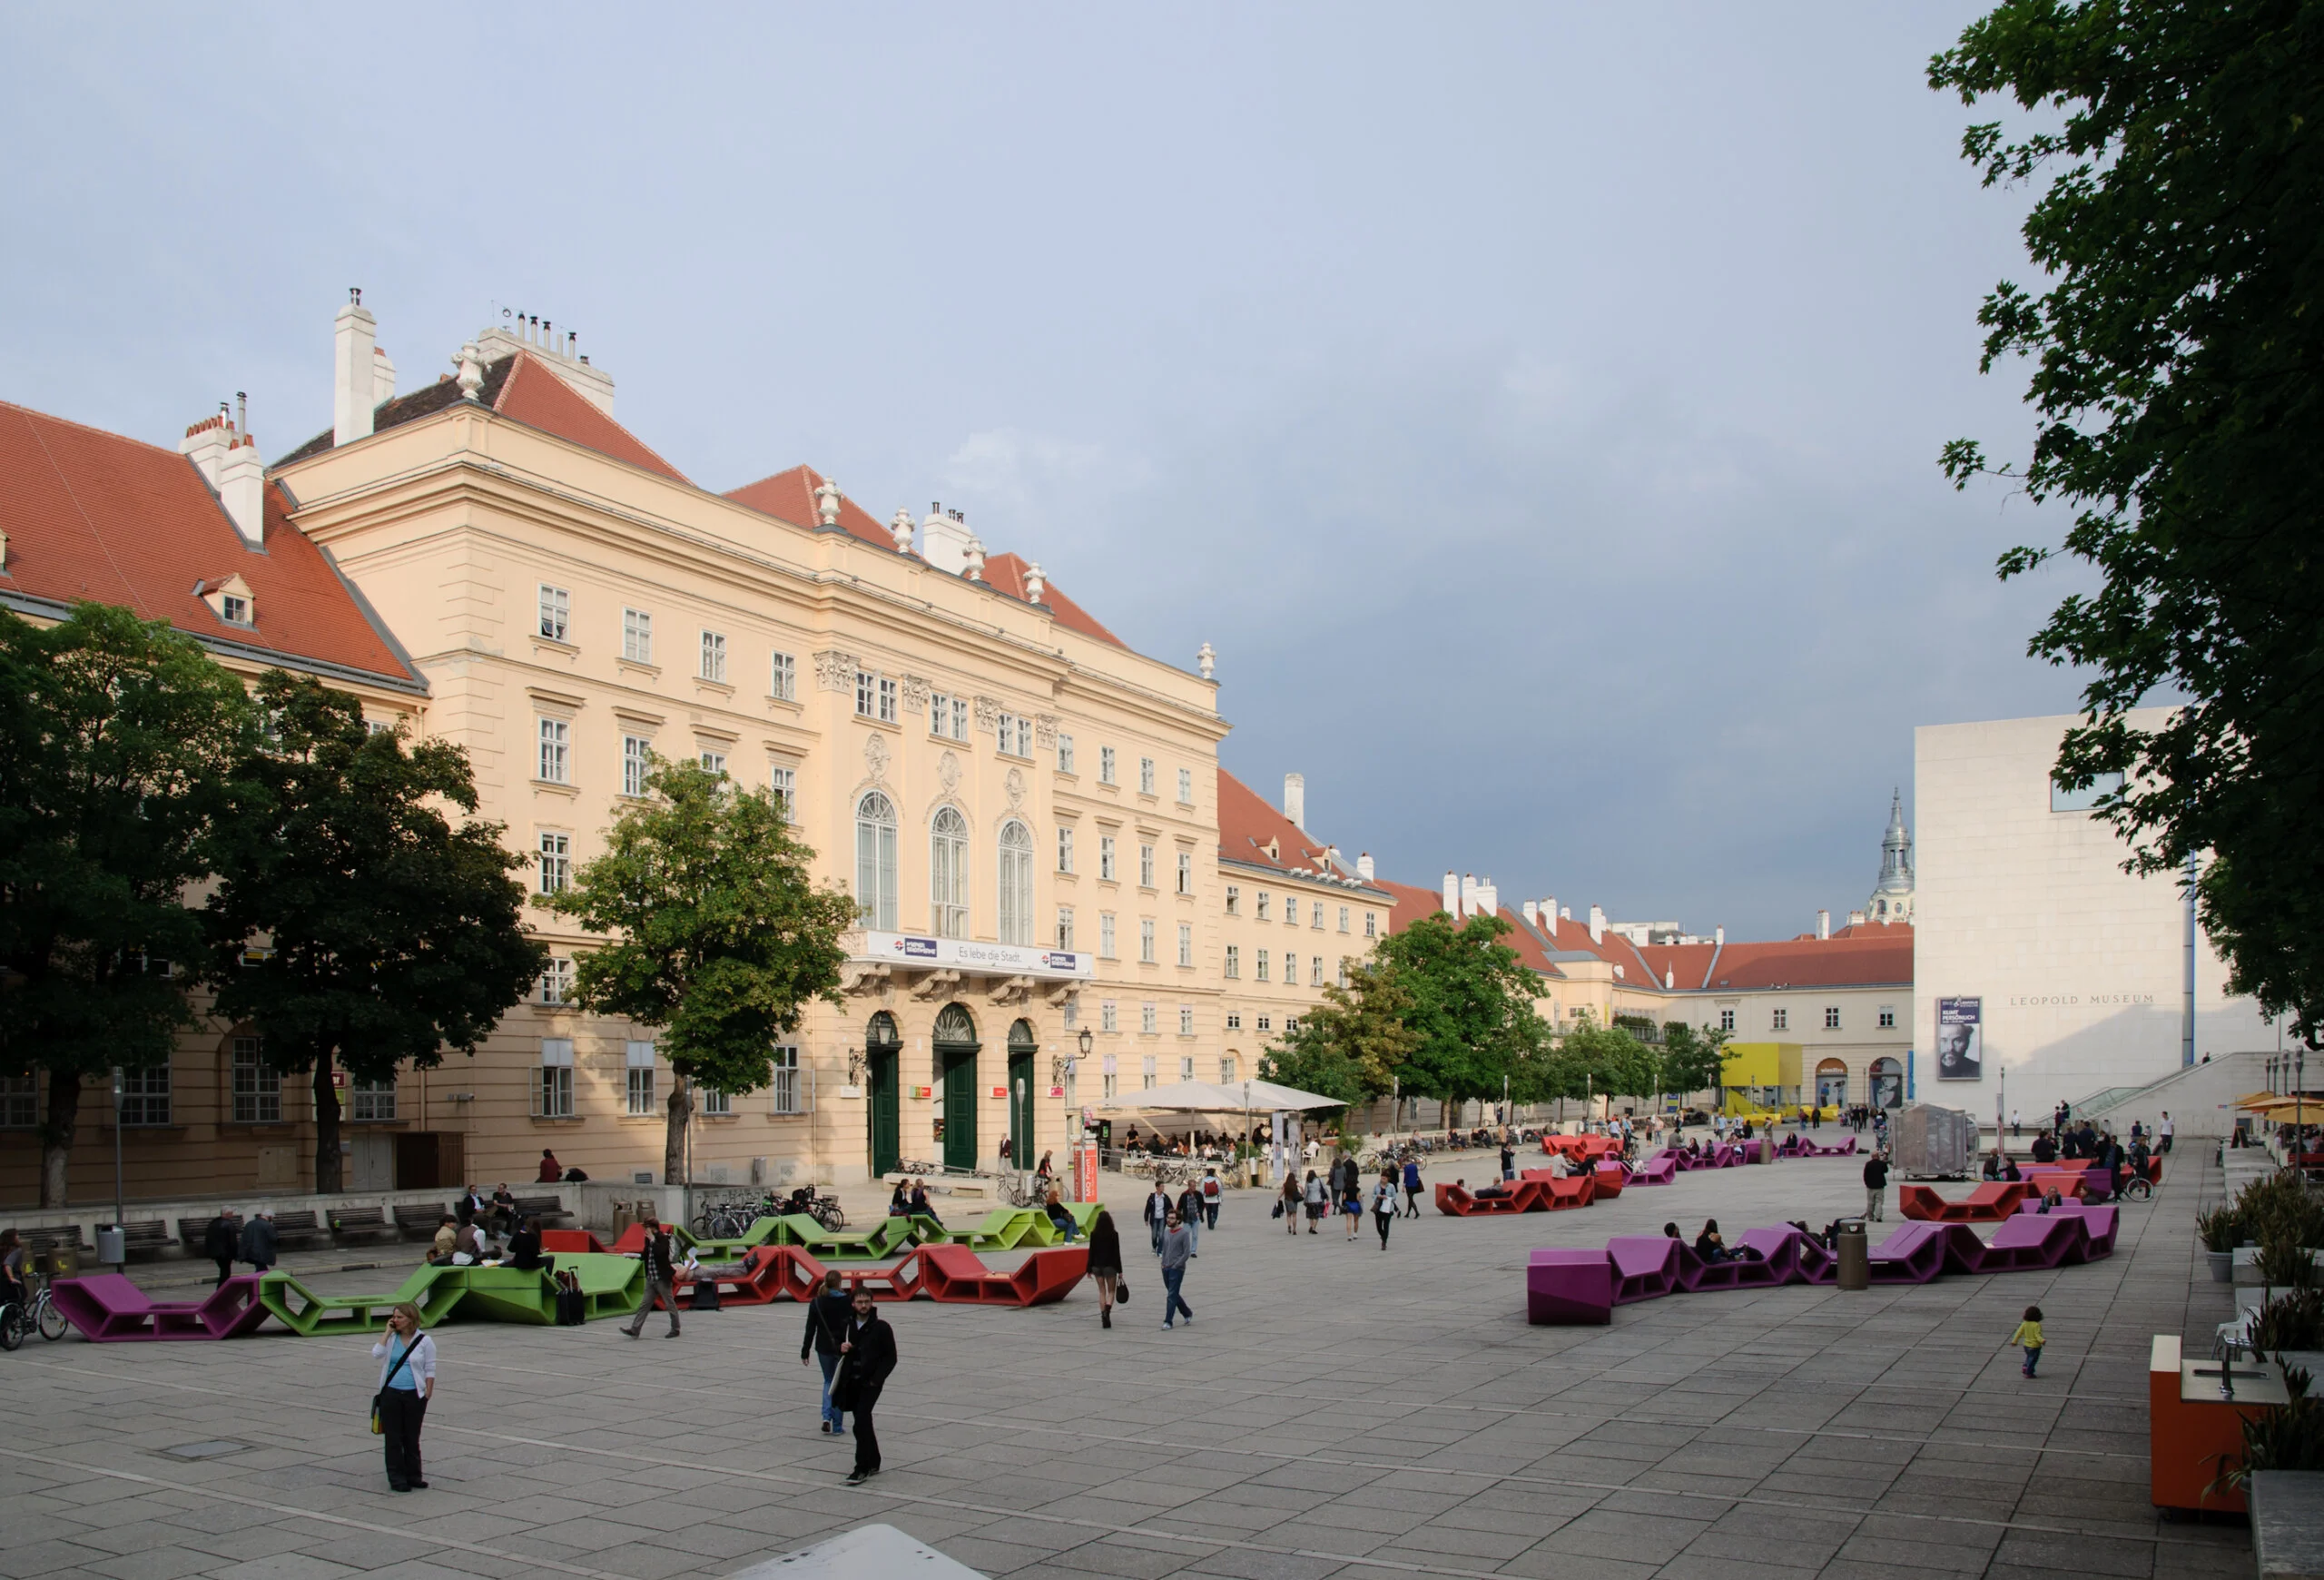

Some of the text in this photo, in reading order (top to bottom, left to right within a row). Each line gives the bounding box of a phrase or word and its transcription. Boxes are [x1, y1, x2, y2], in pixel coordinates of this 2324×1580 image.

[959, 946, 1023, 963] Es lebe die Stadt.
[2010, 994, 2153, 1005] LEOPOLD MUSEUM
[1086, 1181, 1091, 1197] MQ
